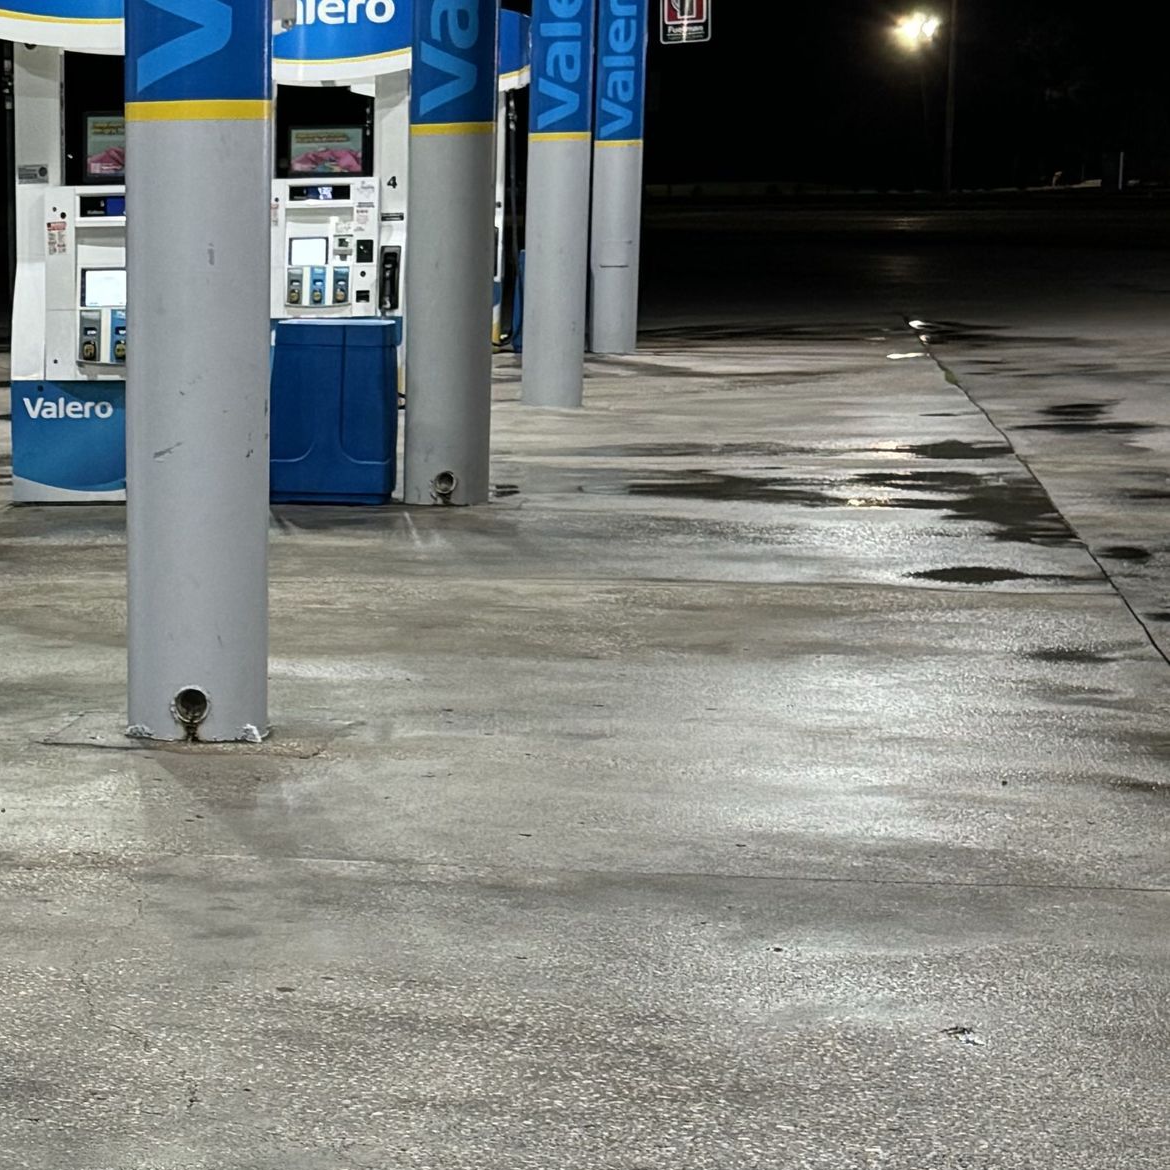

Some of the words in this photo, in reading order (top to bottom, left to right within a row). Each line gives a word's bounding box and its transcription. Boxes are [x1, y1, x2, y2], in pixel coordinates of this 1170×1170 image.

[296, 0, 395, 25] lero
[387, 176, 397, 188] 4
[22, 397, 113, 419] Valero
